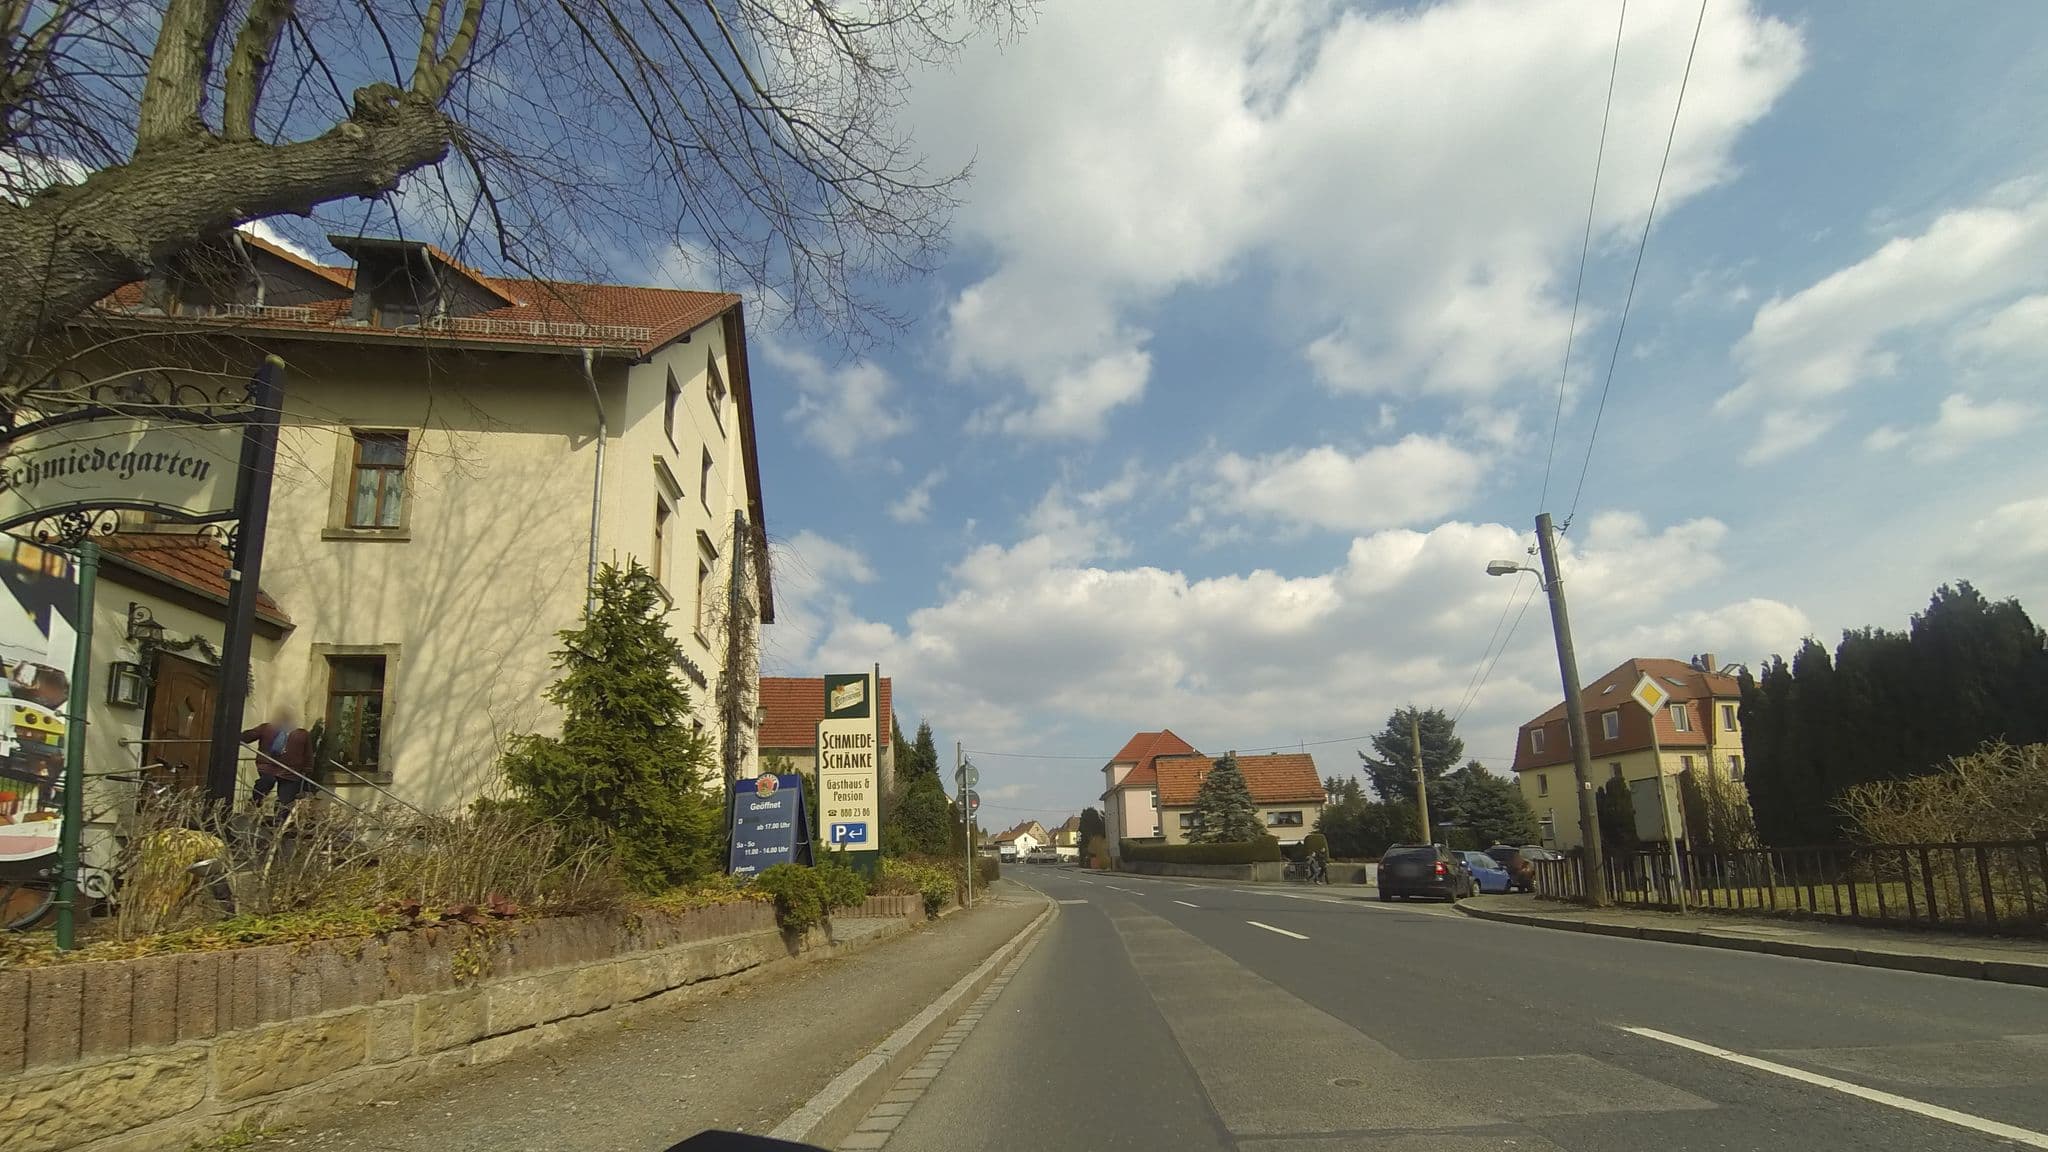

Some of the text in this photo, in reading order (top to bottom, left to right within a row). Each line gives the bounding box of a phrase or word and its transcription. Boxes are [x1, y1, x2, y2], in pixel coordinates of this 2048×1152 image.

[822, 731, 875, 749] SCHMIEDE-
[822, 750, 872, 769] SCHÄNKE
[827, 778, 870, 790] Gasthaus &
[833, 791, 864, 802] Pension
[750, 801, 781, 811] Geöffnet
[780, 821, 790, 829] Uhr
[836, 825, 847, 842] P
[747, 840, 755, 848] So
